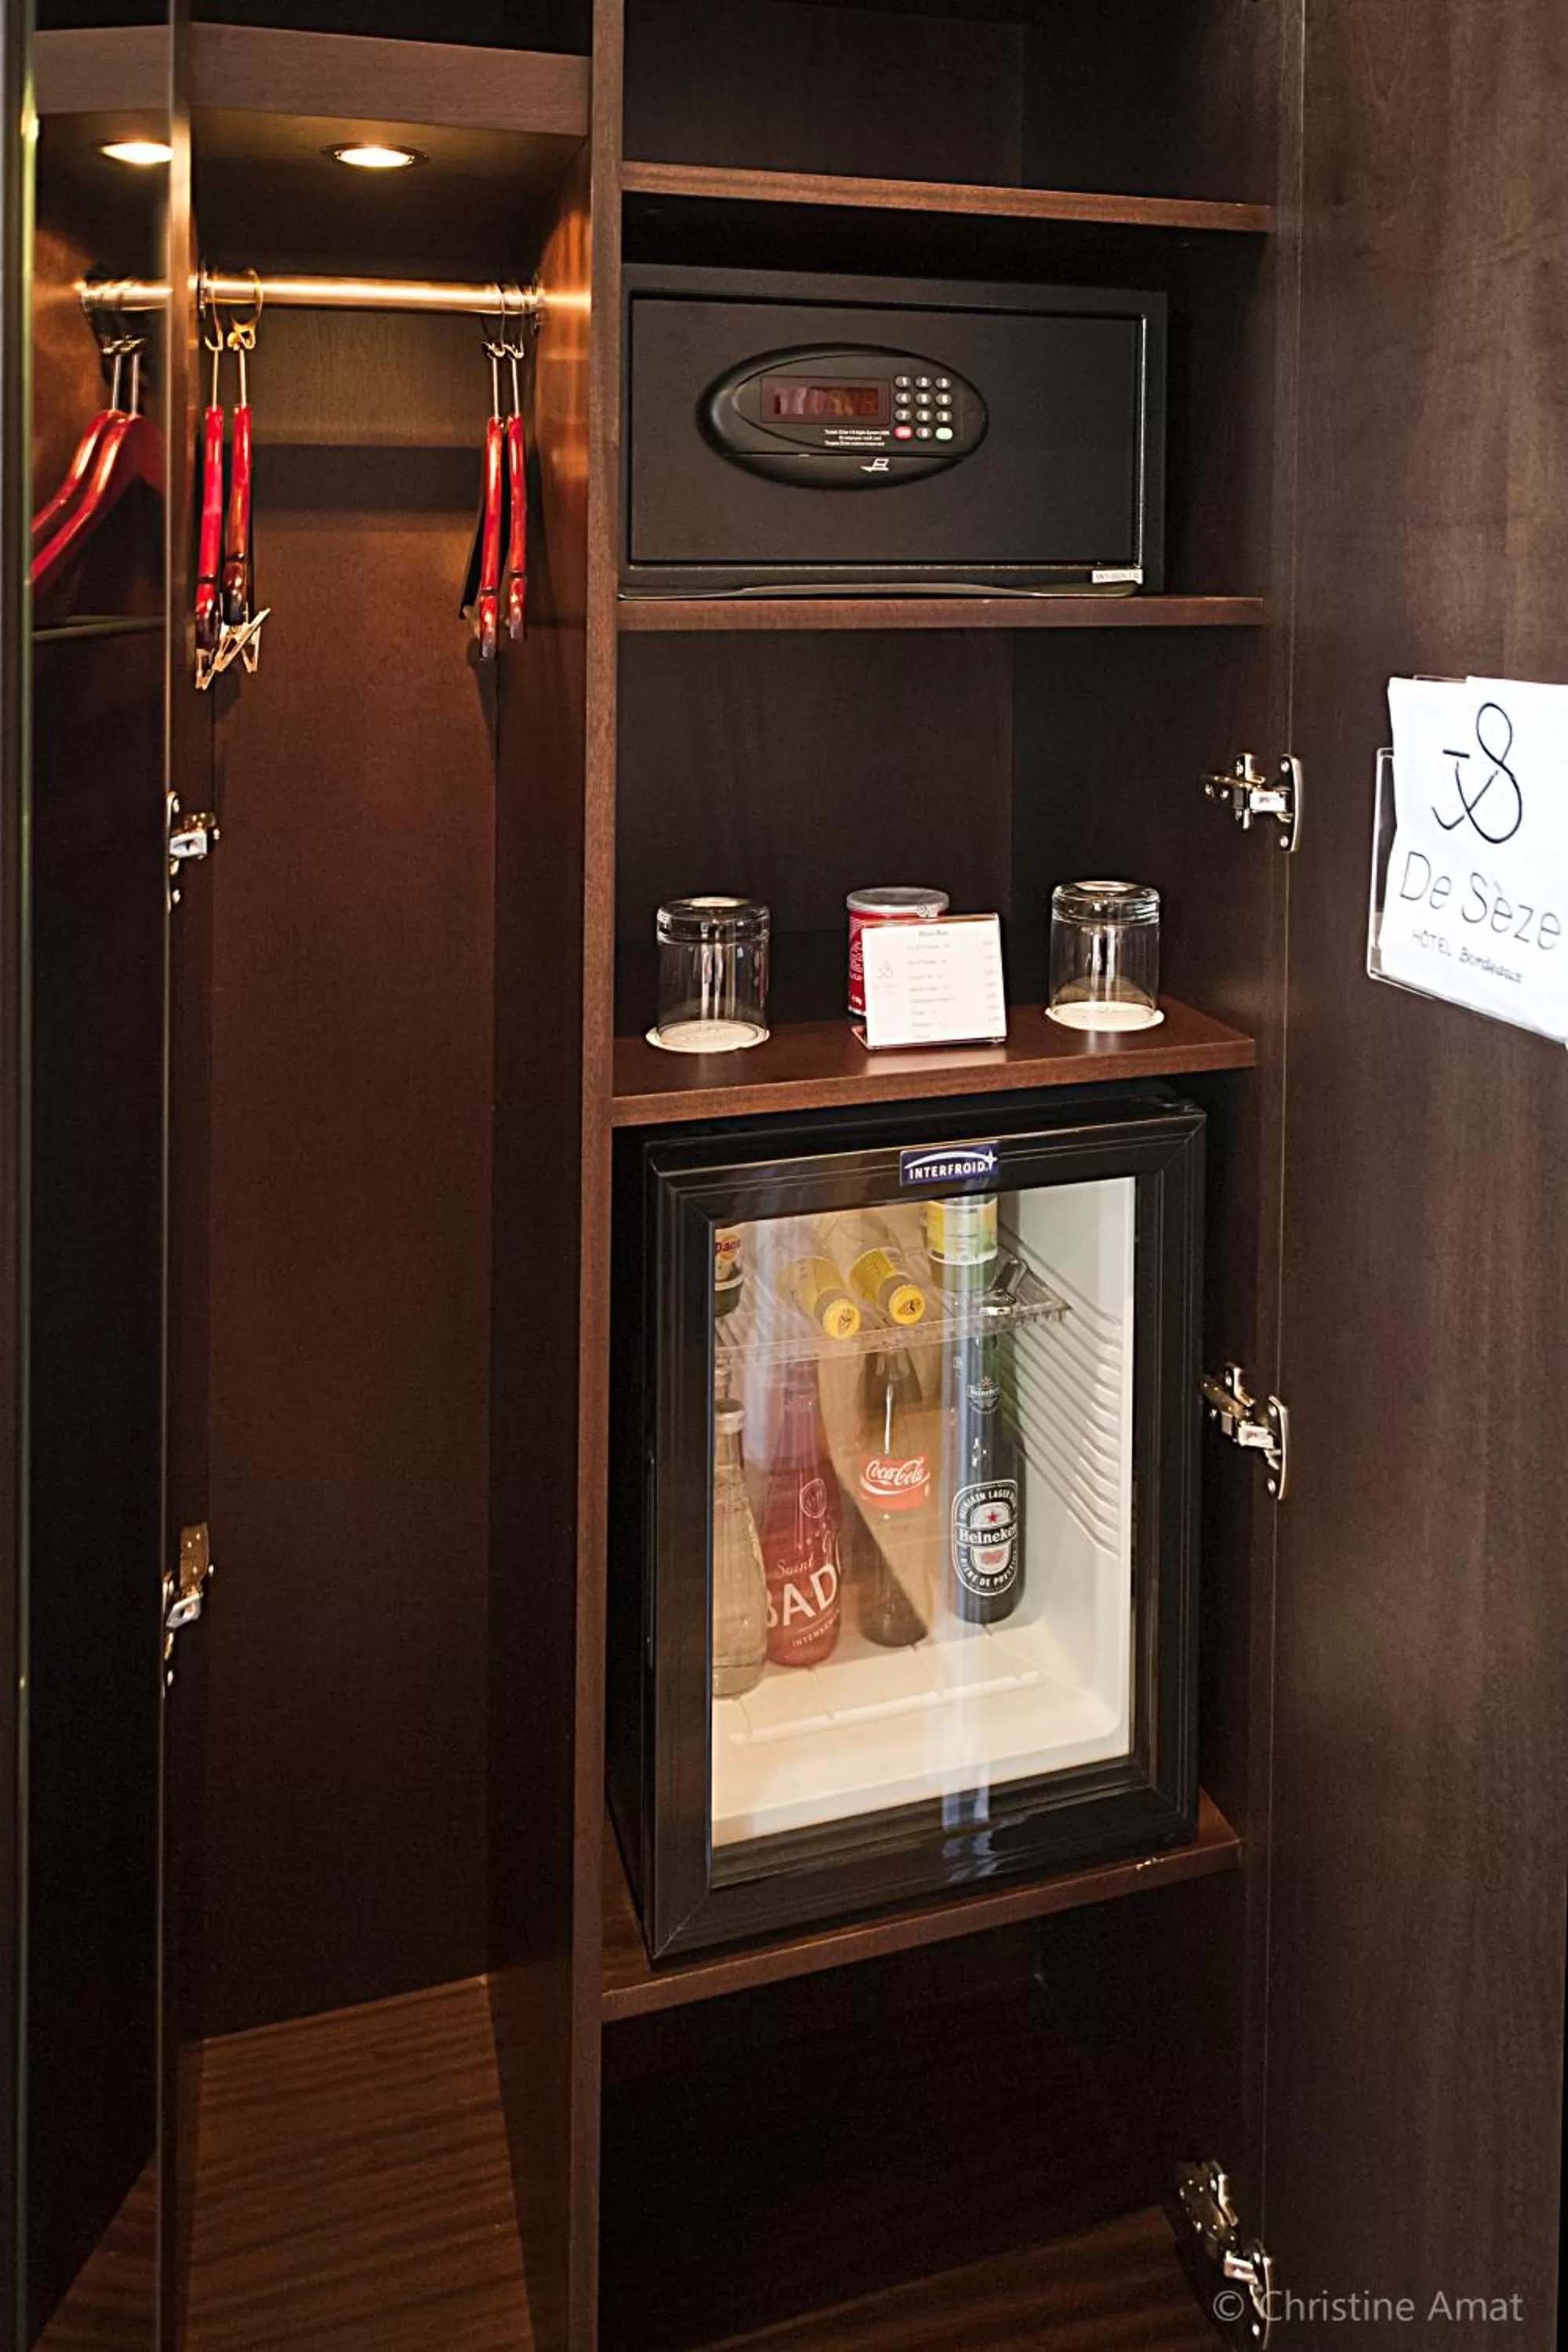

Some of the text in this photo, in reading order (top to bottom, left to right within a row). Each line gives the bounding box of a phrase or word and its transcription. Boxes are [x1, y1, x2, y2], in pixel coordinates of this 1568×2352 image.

[1400, 851, 1562, 950] De Sèze
[909, 1161, 985, 1179] INTERFROID
